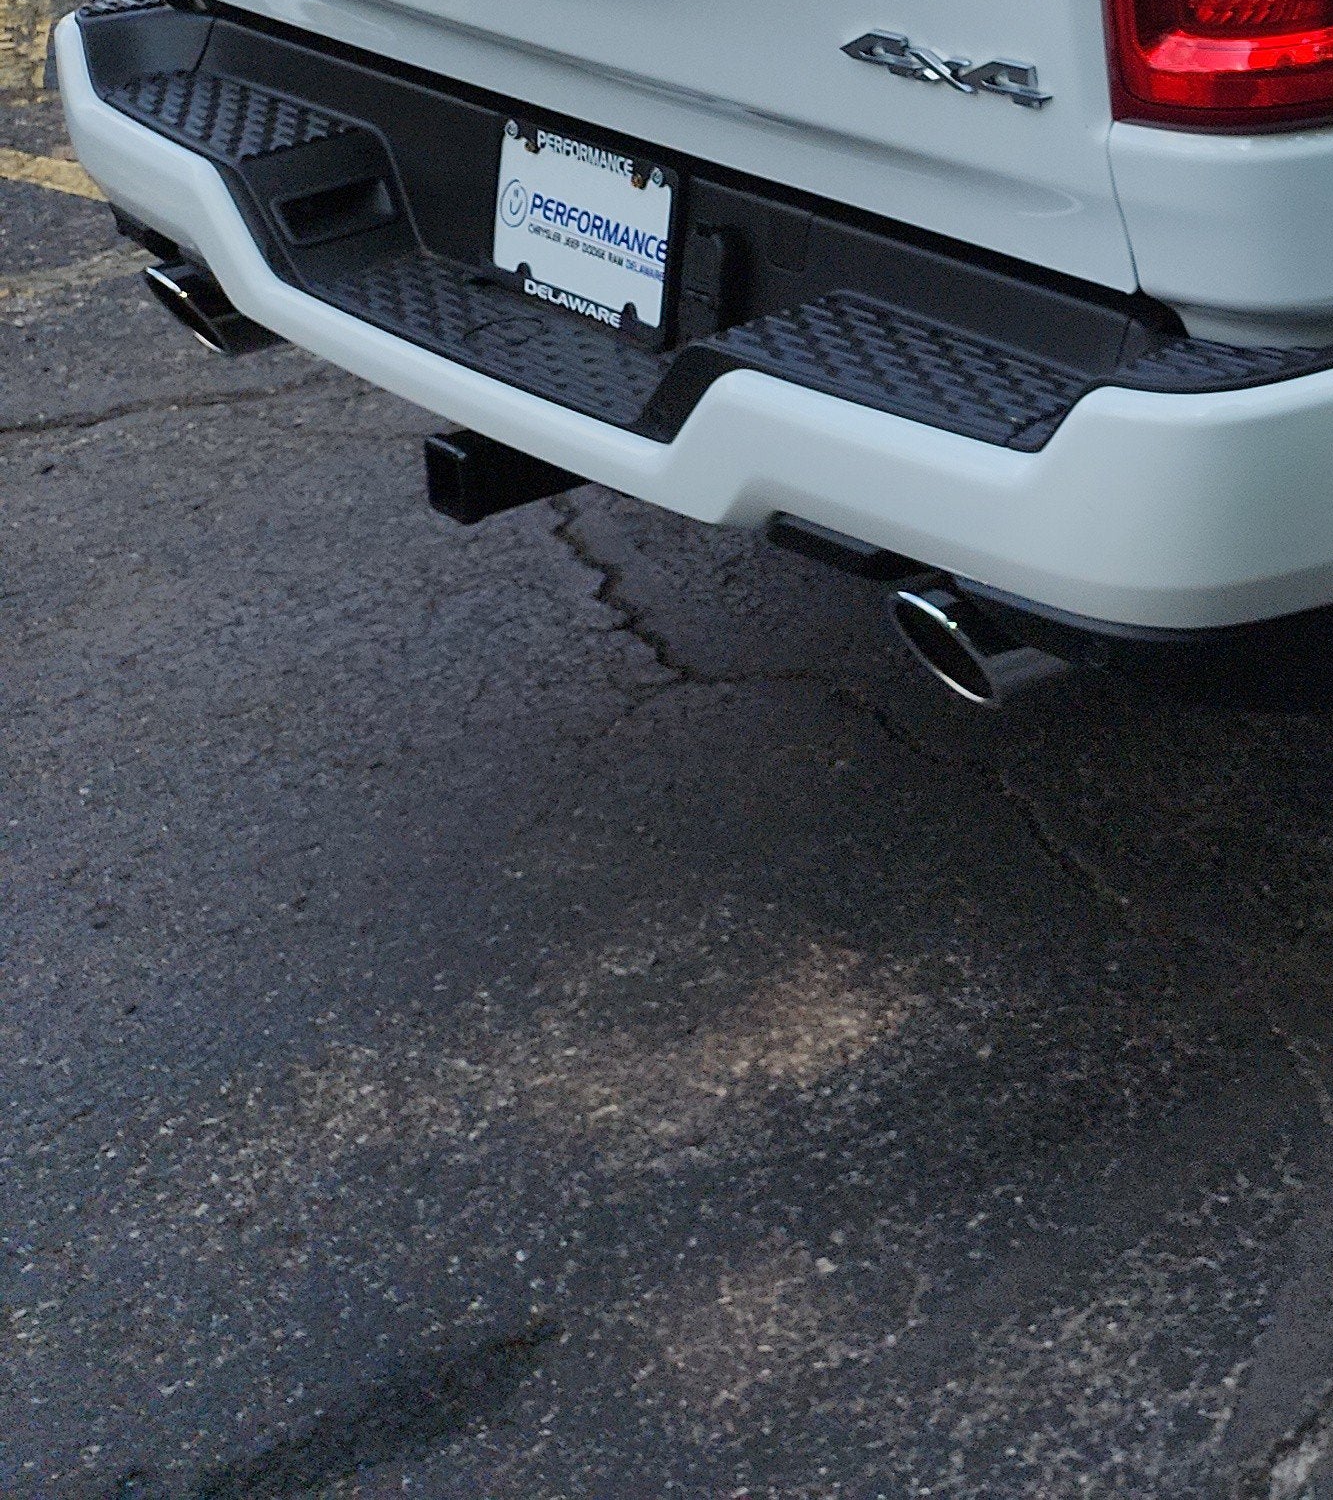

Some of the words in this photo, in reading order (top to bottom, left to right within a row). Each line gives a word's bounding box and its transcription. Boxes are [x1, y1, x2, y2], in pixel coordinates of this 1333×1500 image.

[536, 128, 634, 178] PERFORMANCE
[529, 192, 669, 264] PERFORMANCE
[523, 277, 622, 329] DELAWARE
